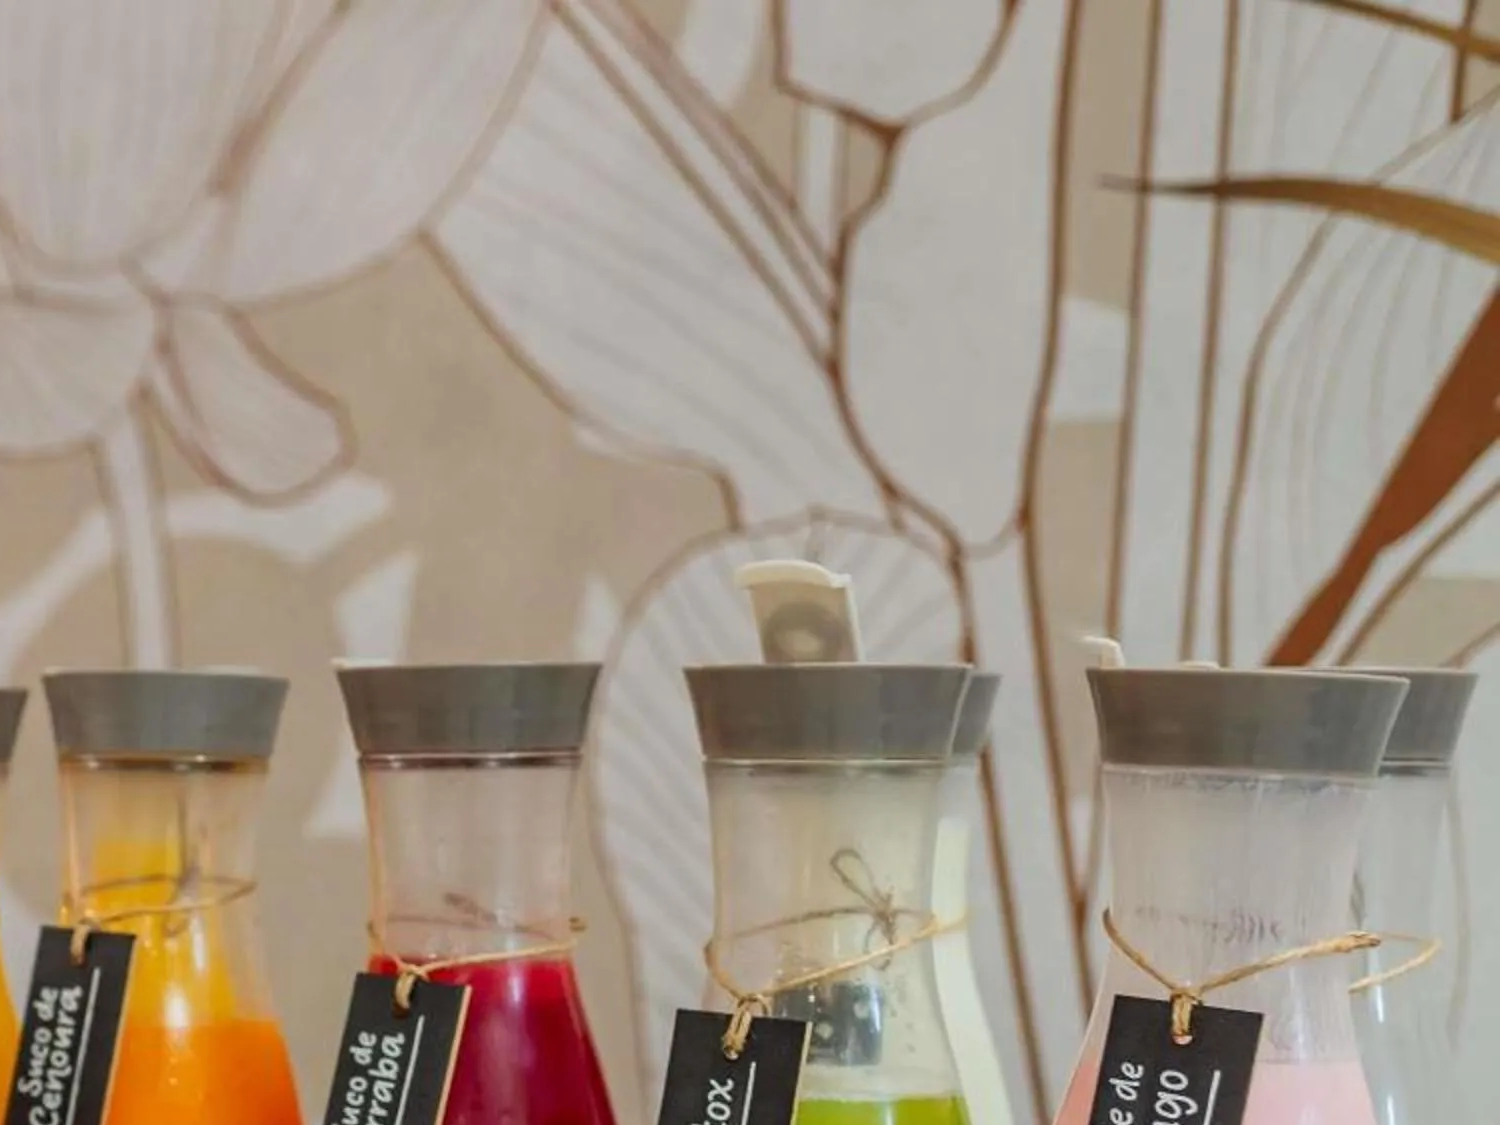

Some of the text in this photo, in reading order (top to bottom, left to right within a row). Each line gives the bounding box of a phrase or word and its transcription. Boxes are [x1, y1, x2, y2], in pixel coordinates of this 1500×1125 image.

[17, 986, 59, 1097] Suco de
[349, 1030, 377, 1065] de
[1109, 1061, 1145, 1101] de
